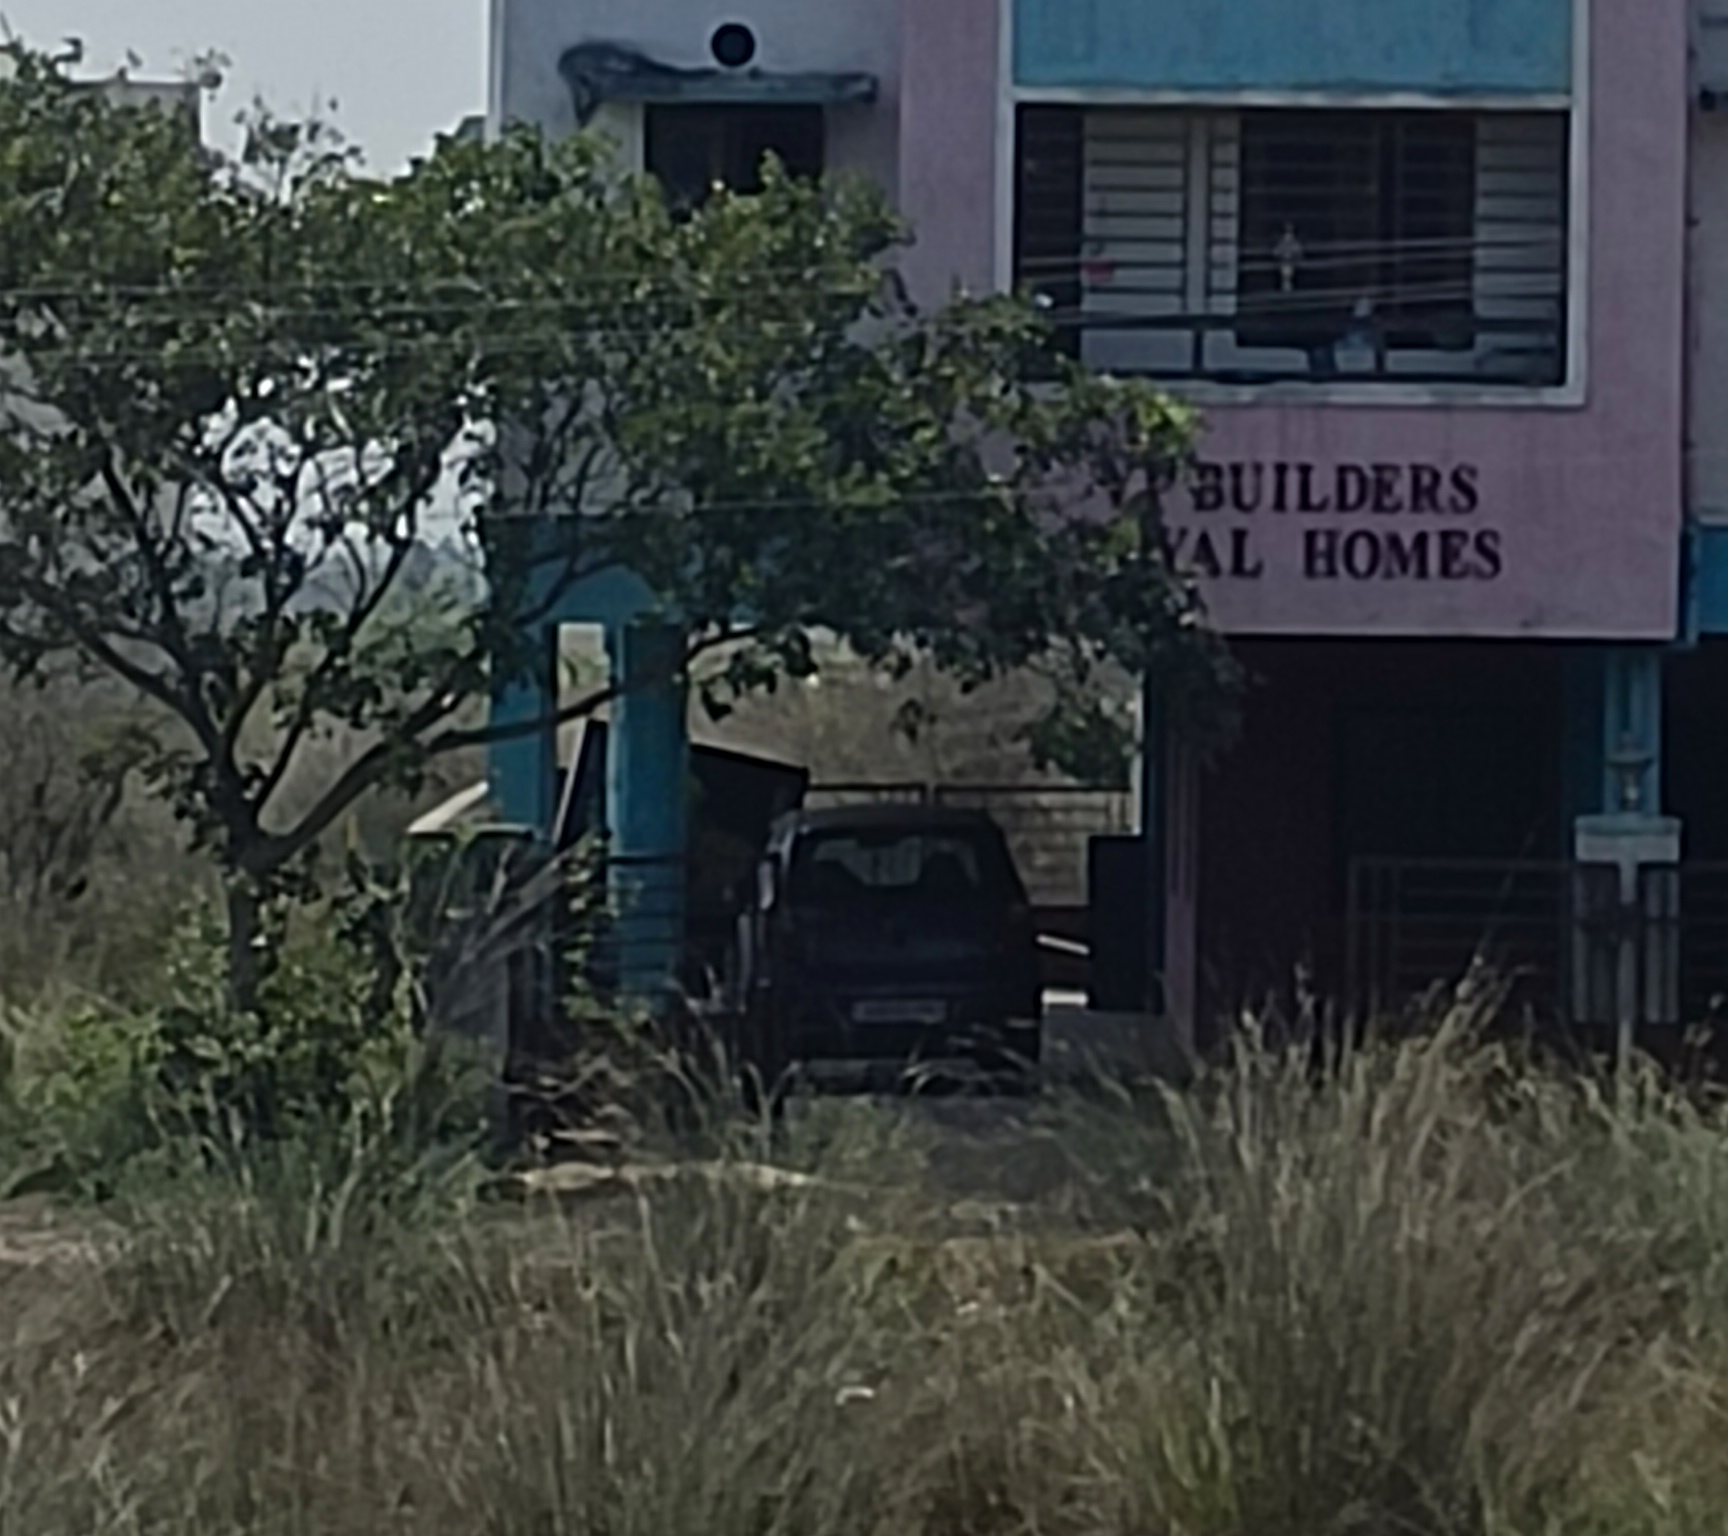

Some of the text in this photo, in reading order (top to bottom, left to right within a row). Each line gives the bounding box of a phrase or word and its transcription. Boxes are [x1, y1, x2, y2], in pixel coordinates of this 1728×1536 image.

[1192, 462, 1479, 515] BUILDERS
[1161, 526, 1502, 580] YAL HOMES
